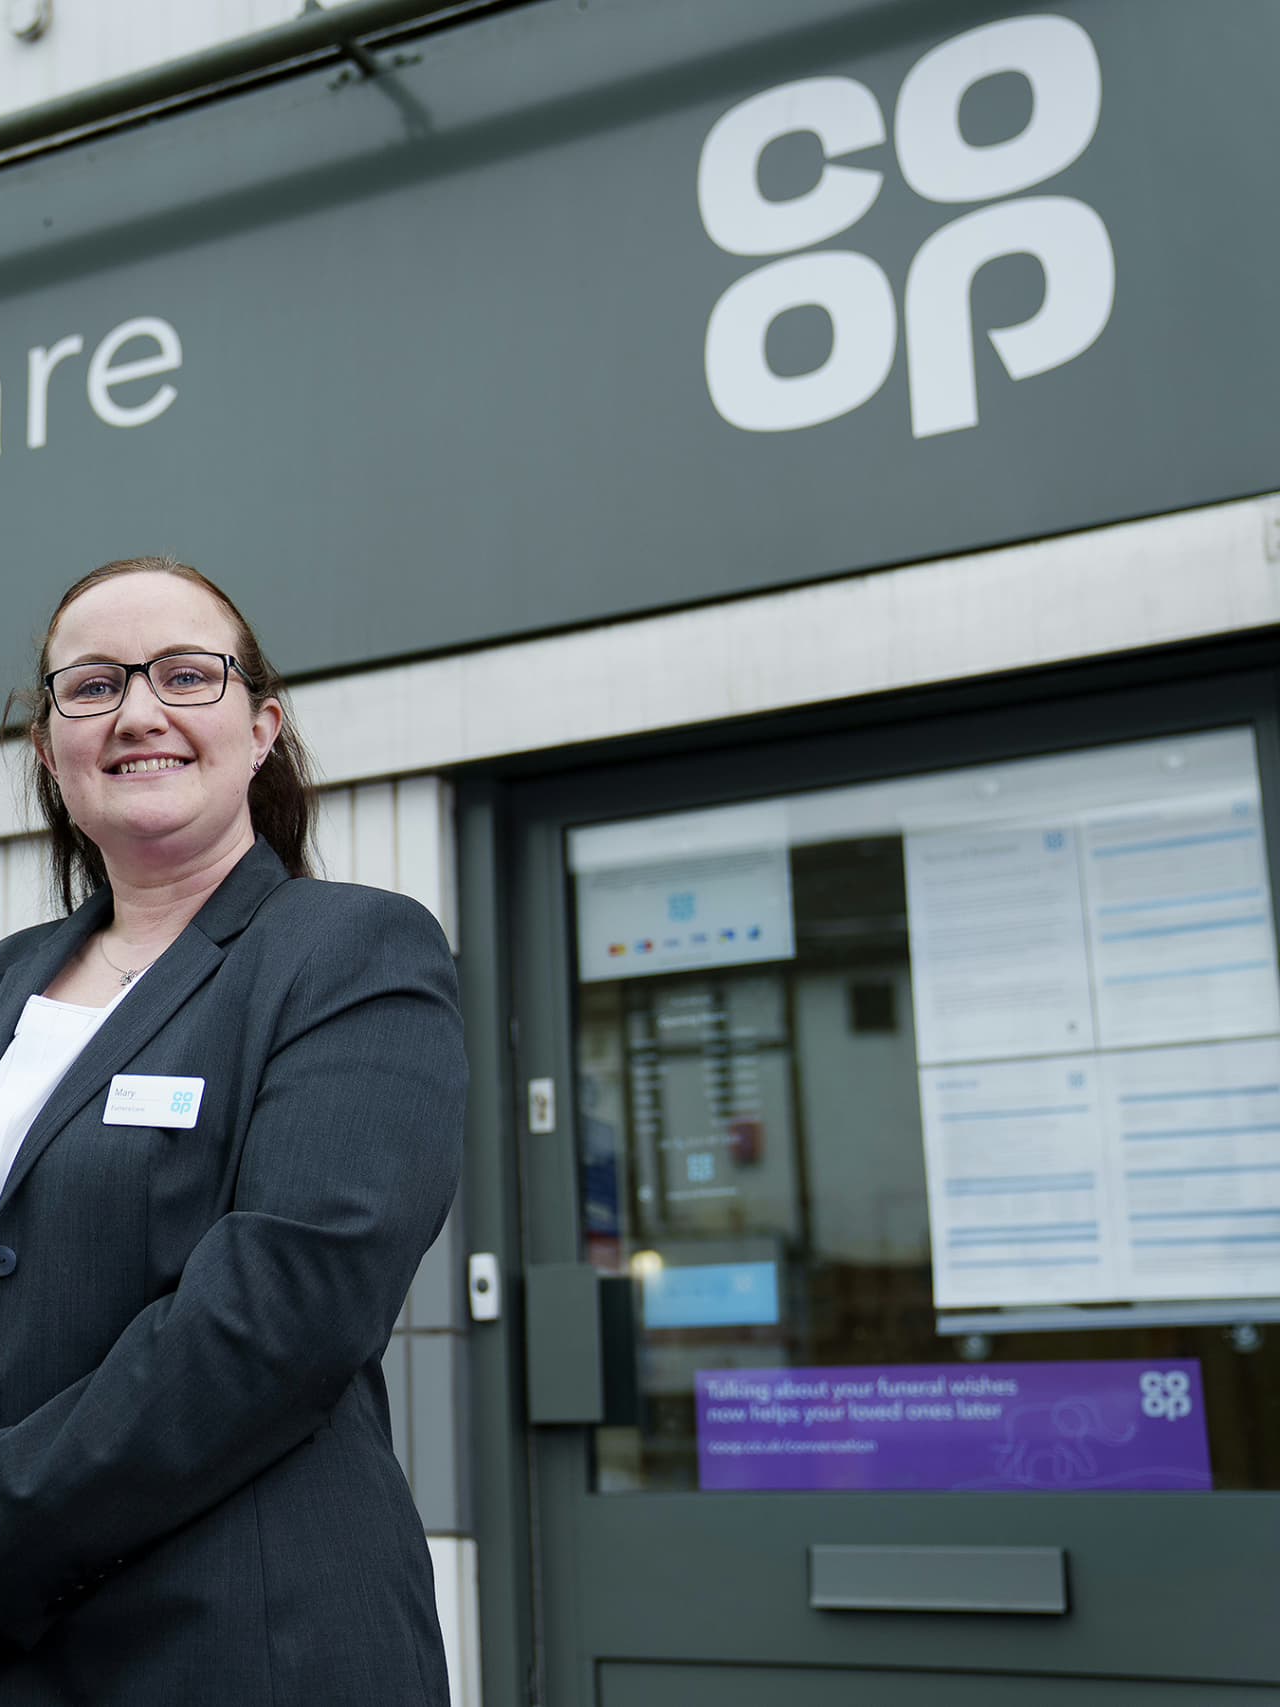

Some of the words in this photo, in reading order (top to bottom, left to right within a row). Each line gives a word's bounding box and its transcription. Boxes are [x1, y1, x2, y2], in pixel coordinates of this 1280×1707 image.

[113, 1087, 136, 1100] Mary
[706, 1379, 770, 1404] Talking
[773, 1379, 829, 1399] about
[831, 1382, 875, 1403] your
[876, 1374, 947, 1398] funeral
[947, 1374, 1018, 1397] wishes
[706, 1406, 747, 1424] now
[748, 1400, 801, 1427] helps
[803, 1406, 846, 1427] your
[847, 1399, 903, 1422] loved
[904, 1403, 955, 1421] ones
[955, 1399, 1003, 1421] later
